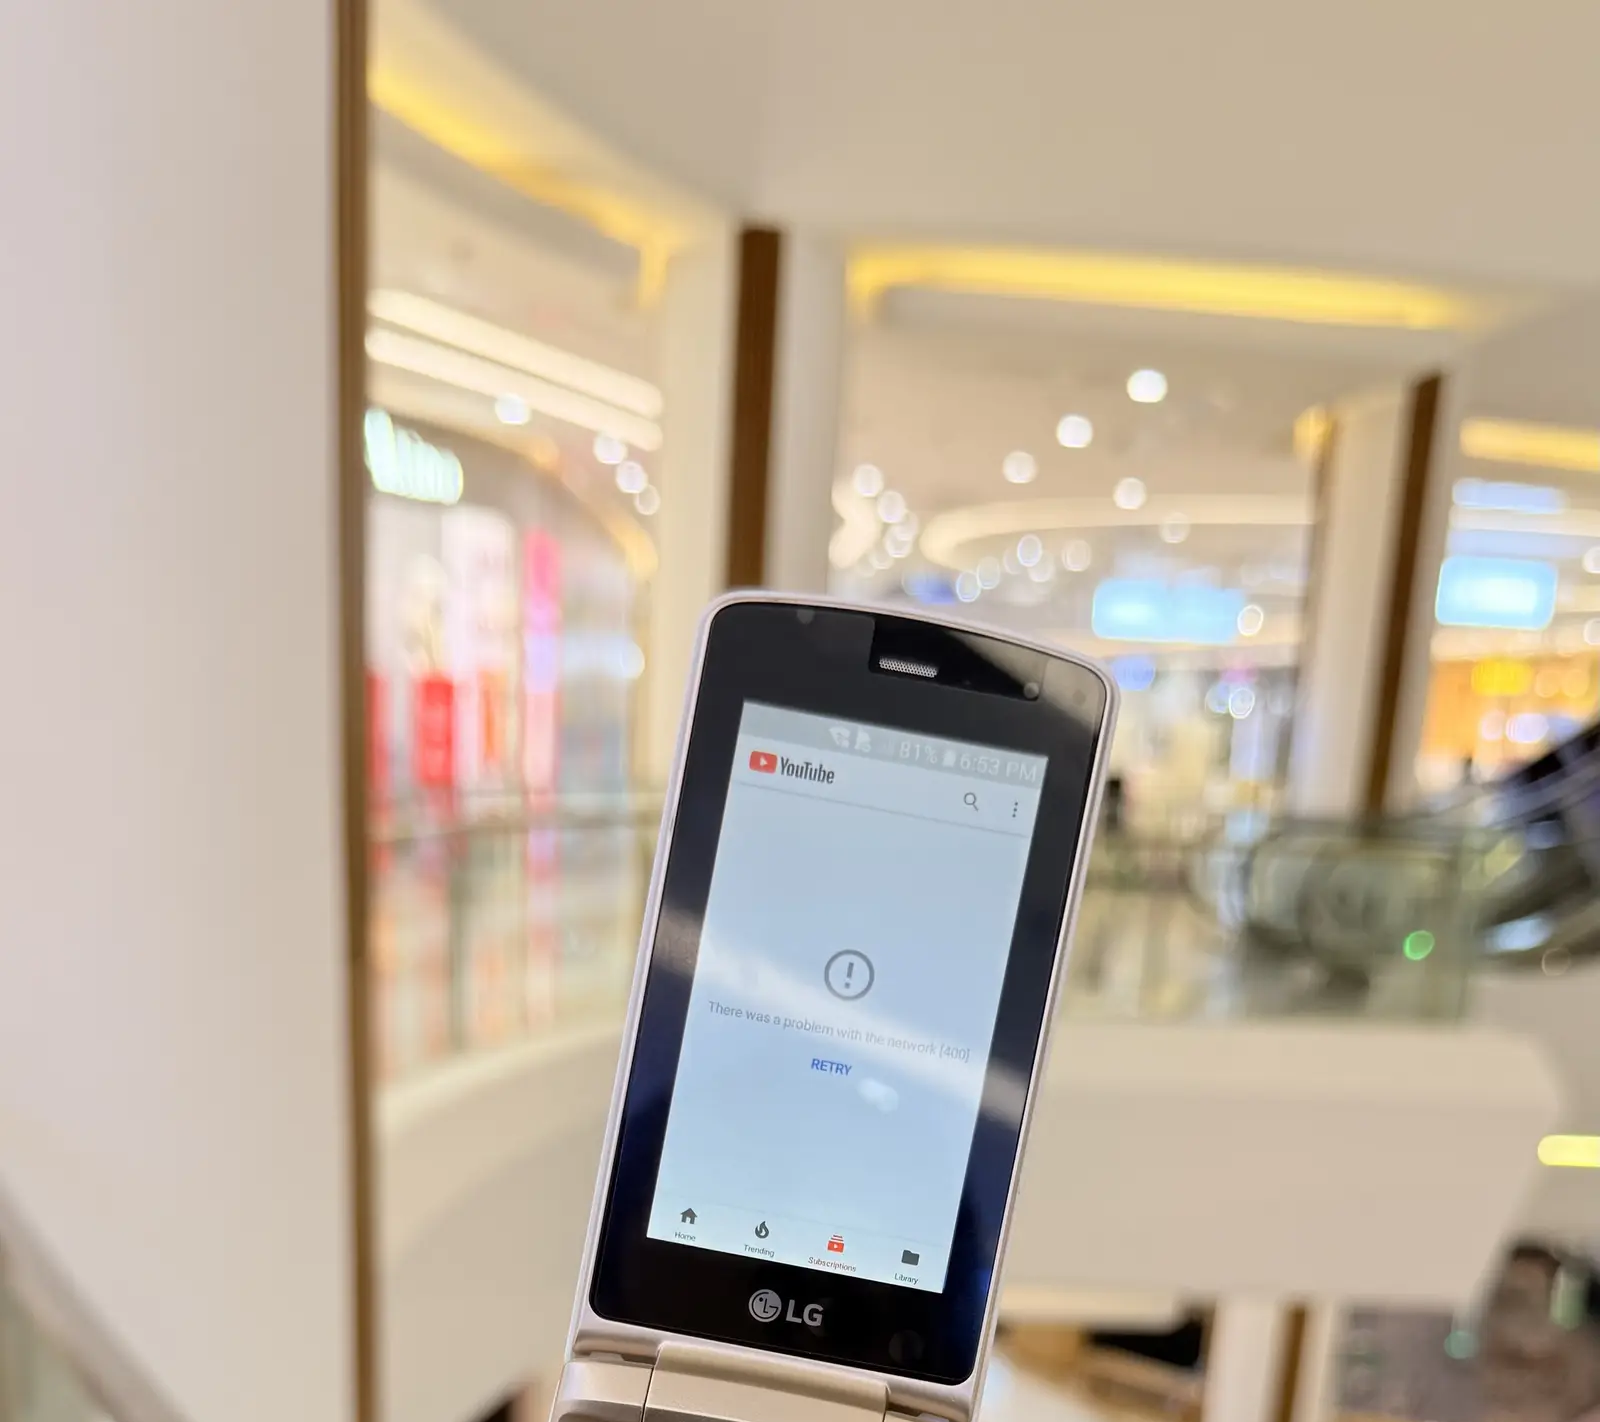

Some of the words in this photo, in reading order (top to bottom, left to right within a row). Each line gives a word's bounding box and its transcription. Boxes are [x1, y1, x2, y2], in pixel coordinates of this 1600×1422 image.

[780, 756, 835, 784] YouTube
[900, 742, 938, 765] 81%
[960, 754, 1000, 776] 6:53
[1006, 762, 1037, 782] PM
[709, 1001, 743, 1018] There
[745, 1010, 771, 1024] was
[783, 1016, 834, 1036] problem
[837, 1026, 863, 1042] with
[865, 1030, 885, 1045] the
[887, 1037, 936, 1055] network
[811, 1058, 852, 1076] RETRY
[675, 1231, 696, 1242] Home
[744, 1244, 775, 1258] Trending
[808, 1256, 857, 1273] Subscriptions
[894, 1273, 919, 1285] Library
[786, 1300, 824, 1327] LG
